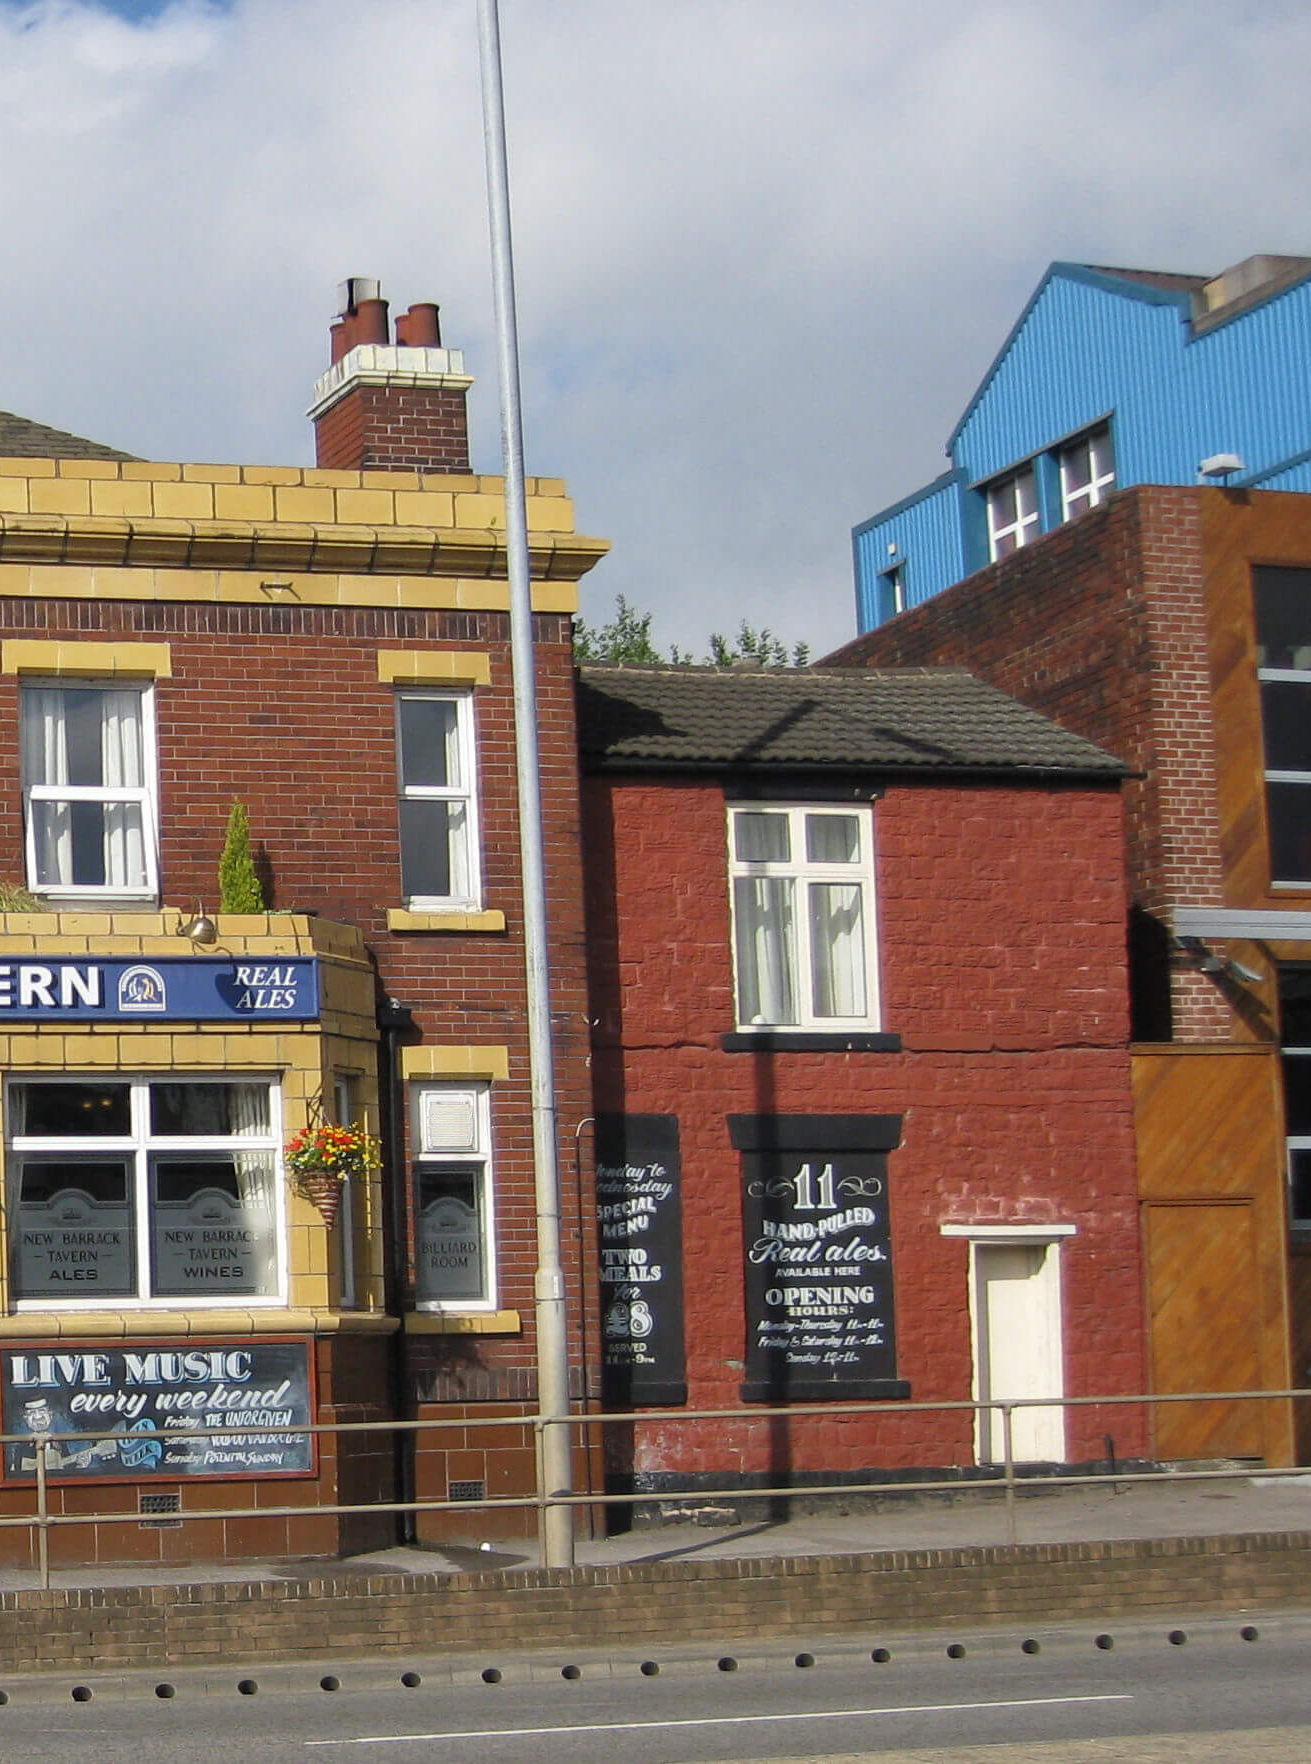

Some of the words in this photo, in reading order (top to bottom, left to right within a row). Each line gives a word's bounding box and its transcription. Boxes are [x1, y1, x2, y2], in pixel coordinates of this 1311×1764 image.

[234, 966, 297, 987] REAL
[236, 988, 295, 1009] ALES
[646, 1162, 666, 1177] to
[793, 1163, 838, 1210] 11
[596, 1196, 657, 1219] SPECIAL
[603, 1214, 649, 1237] MENU
[762, 1207, 876, 1241] HAND-PULLED
[24, 1233, 53, 1245] NEW
[62, 1232, 122, 1245] BARRACK
[164, 1232, 193, 1243] NEW
[202, 1231, 261, 1243] BARRAC
[48, 1251, 99, 1262] TAVERN
[189, 1249, 238, 1260] TAVERN
[422, 1241, 477, 1255] BILLIARD
[602, 1248, 647, 1265] TWO
[749, 1237, 822, 1264] Real
[431, 1256, 468, 1269] ROOM
[49, 1269, 99, 1281] ALES
[184, 1267, 244, 1278] WINES
[600, 1265, 662, 1282] MEALS
[775, 1267, 831, 1278] AVAILABLE
[834, 1266, 861, 1276] HERE
[765, 1286, 875, 1306] OPENING
[605, 1300, 653, 1337] £8
[758, 1336, 789, 1349] Friday
[801, 1335, 844, 1348] Saturday
[786, 1351, 821, 1365] Sunday
[10, 1354, 111, 1387] LIVE
[122, 1350, 252, 1385] MUSIC
[70, 1389, 151, 1418] every
[155, 1379, 290, 1409] weekend
[164, 1415, 200, 1429] Friday
[205, 1412, 222, 1427] THE
[225, 1409, 293, 1427] UNFORGIVEN
